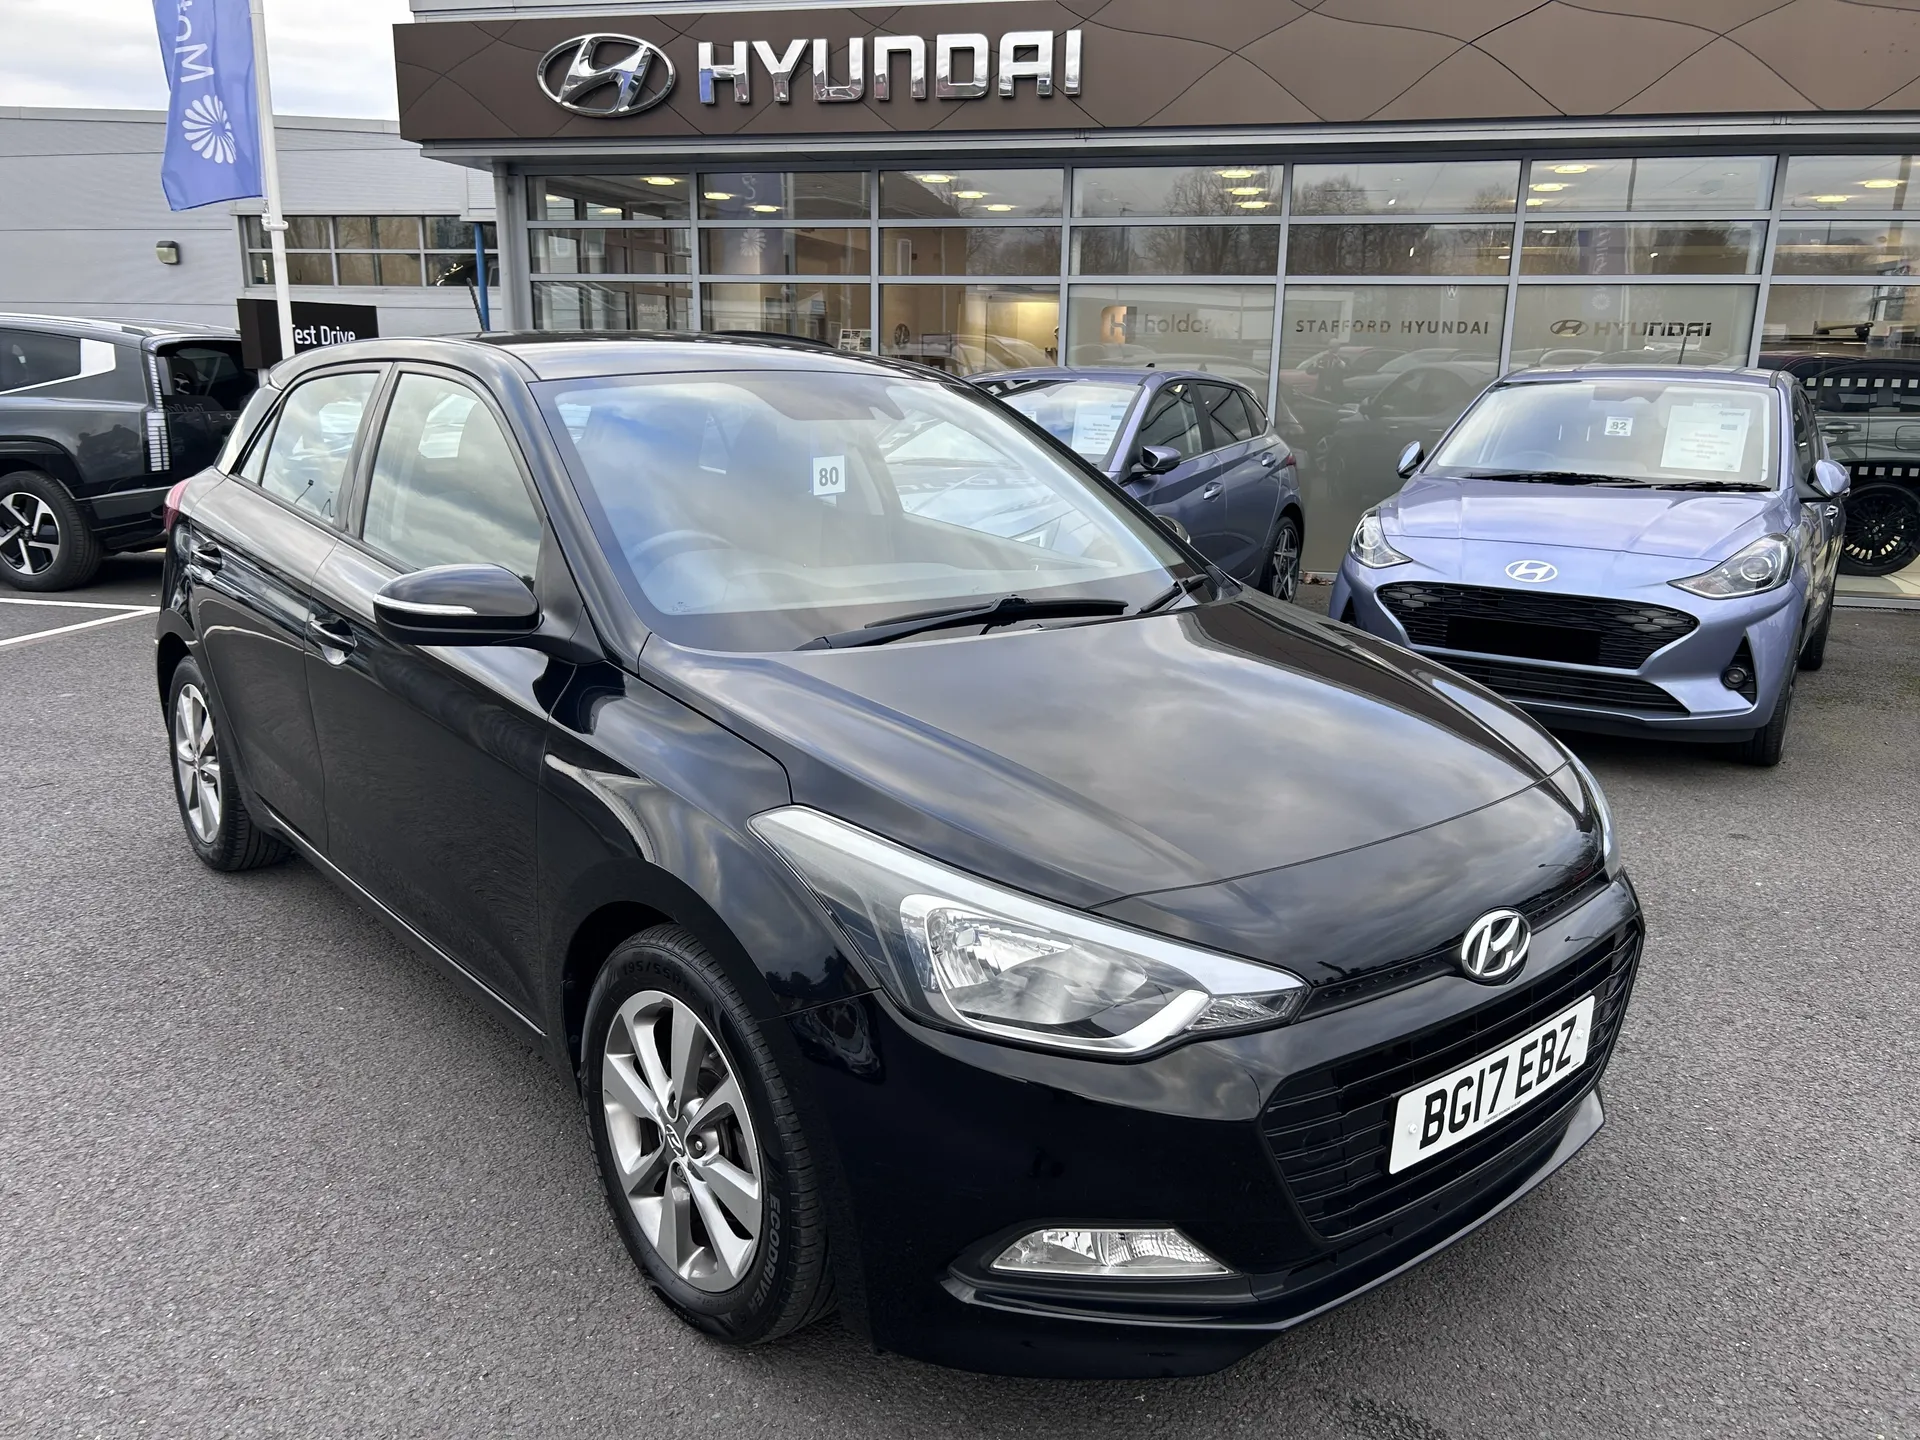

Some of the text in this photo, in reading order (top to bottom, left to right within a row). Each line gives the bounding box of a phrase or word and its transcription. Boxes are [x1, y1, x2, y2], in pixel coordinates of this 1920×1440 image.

[698, 29, 1083, 104] HYUNDAI
[320, 325, 356, 345] Drive
[1295, 319, 1489, 335] STAFFORD HYUNDAI
[1593, 321, 1713, 337] HYUNDAI
[1611, 421, 1627, 431] 82
[818, 466, 840, 487] 80
[1419, 1014, 1578, 1150] BG17 EBZ
